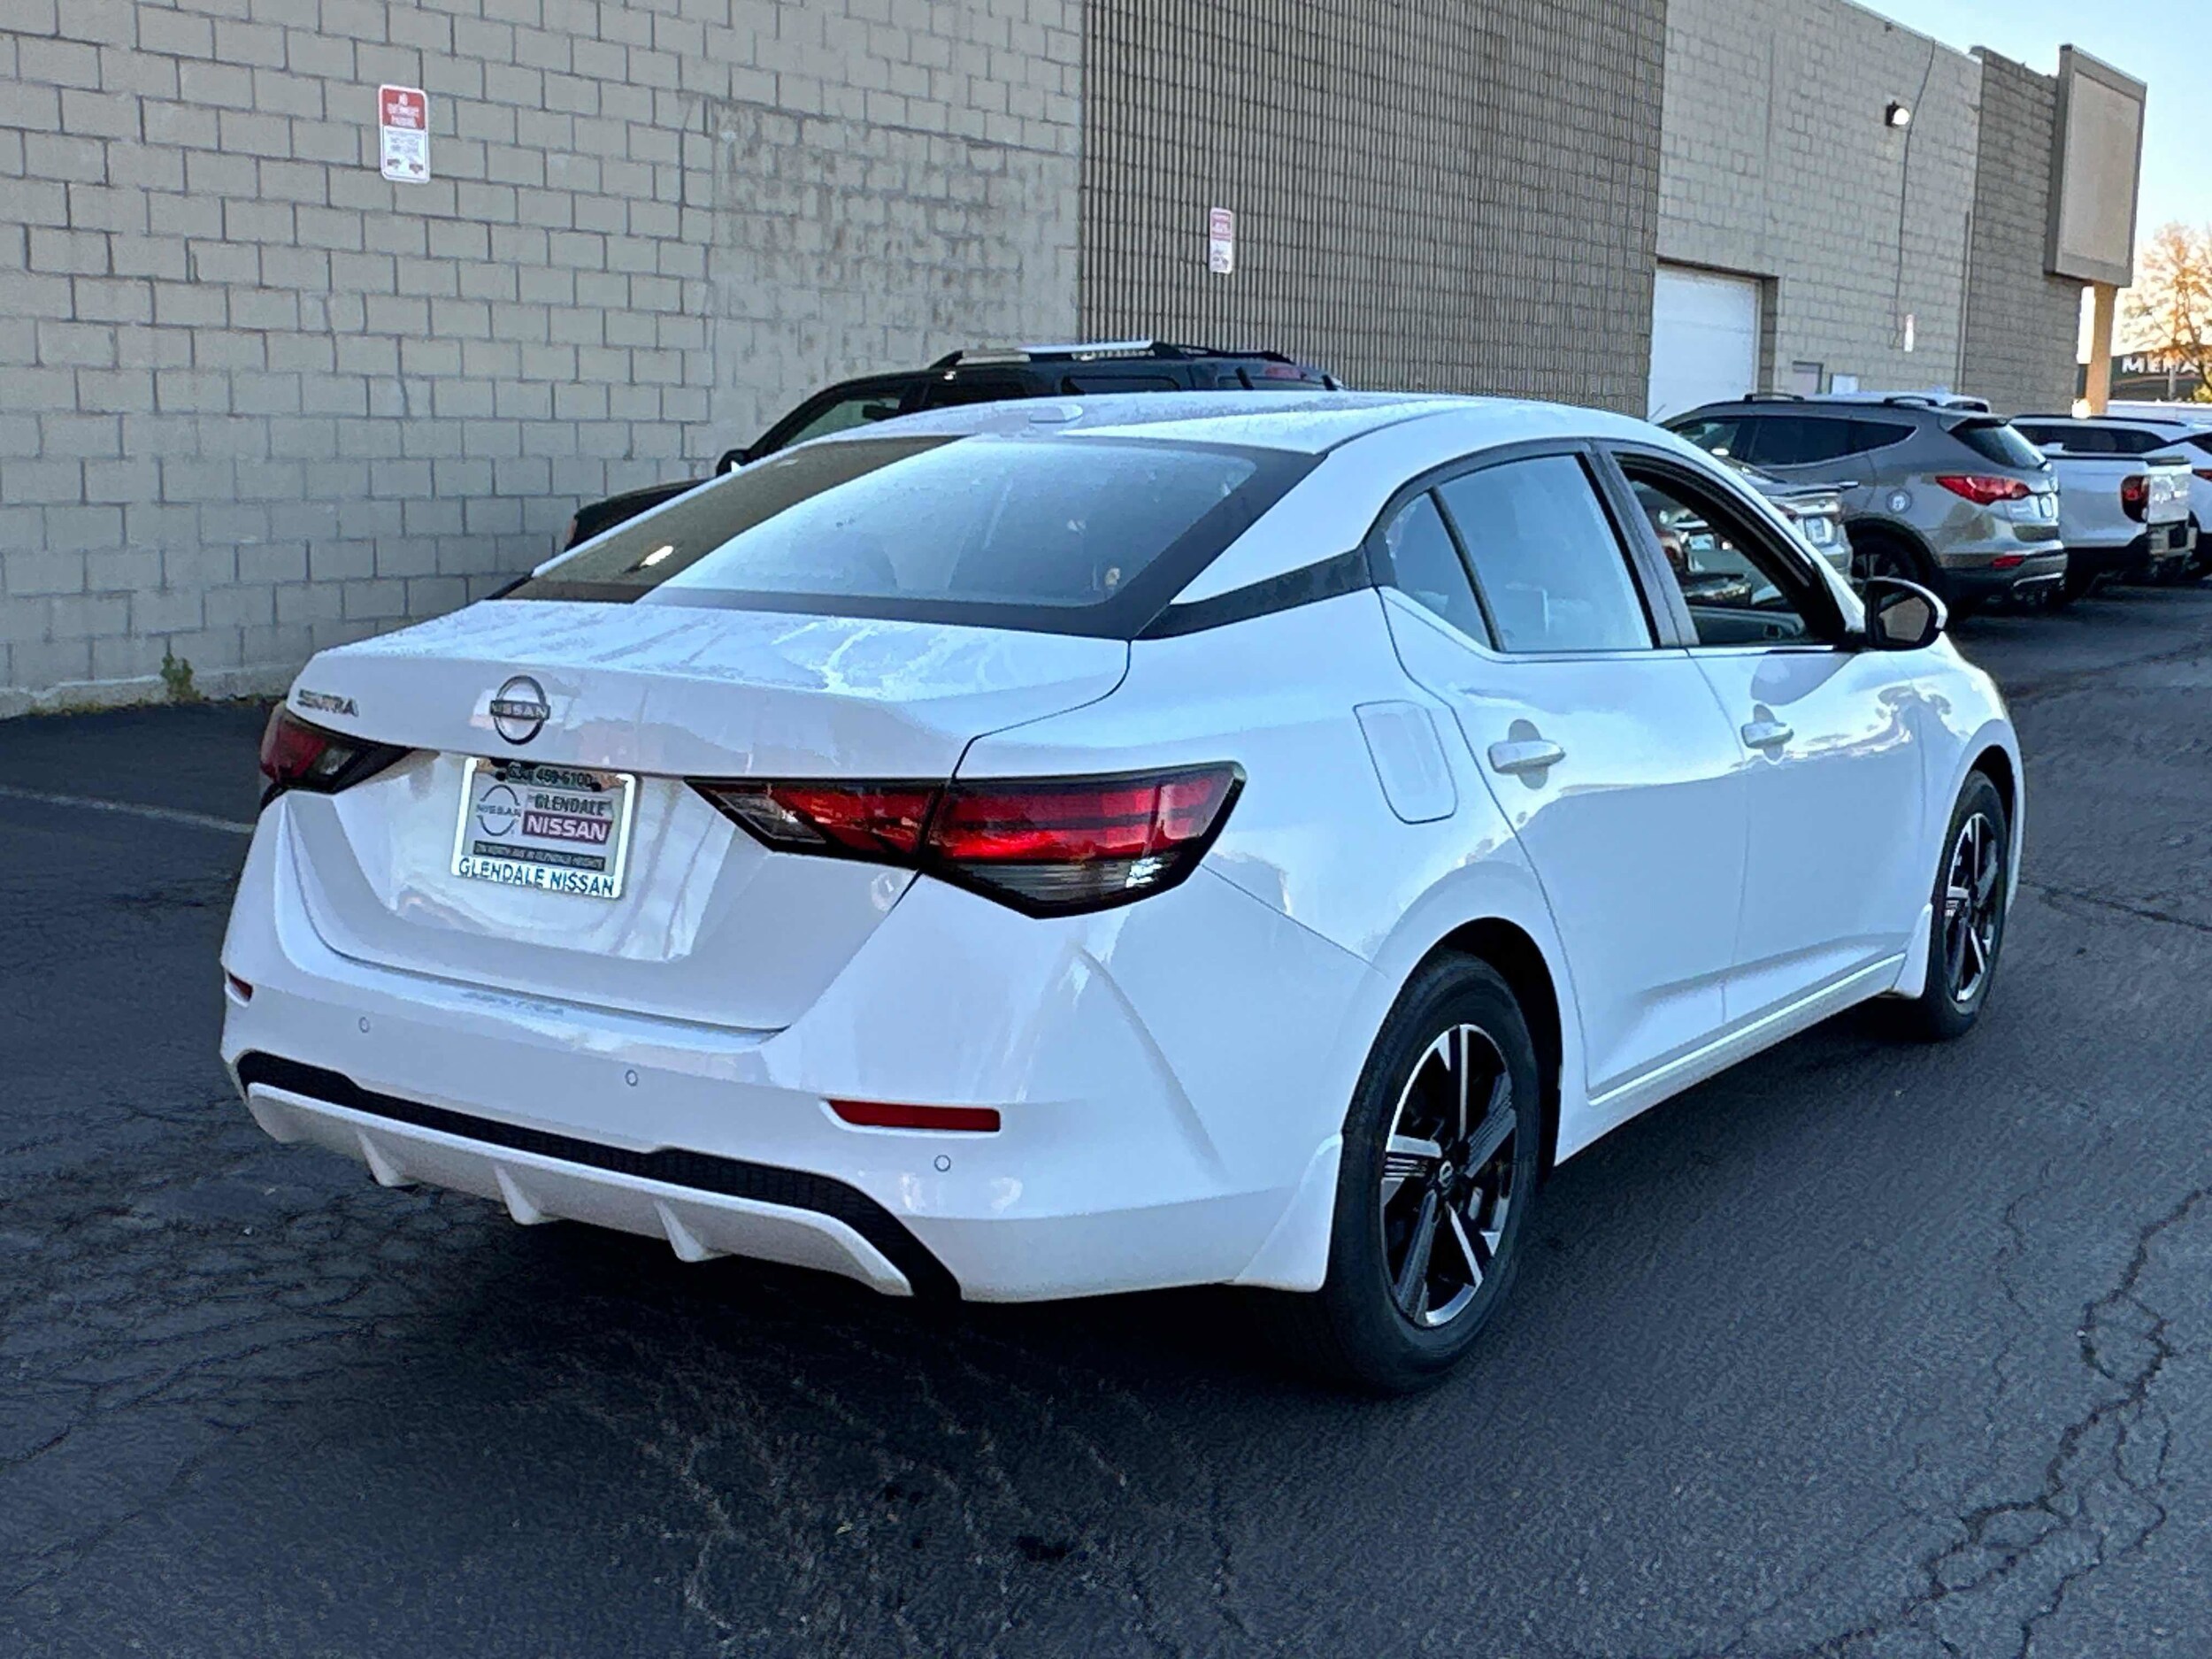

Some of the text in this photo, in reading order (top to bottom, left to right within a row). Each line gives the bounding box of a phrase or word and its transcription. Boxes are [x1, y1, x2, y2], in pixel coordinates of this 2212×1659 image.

[491, 701, 549, 719] NISSAN
[476, 803, 522, 818] NISSAN
[534, 793, 607, 817] GLENDALE
[526, 815, 608, 841] NISSAN
[458, 857, 615, 896] GLENDALE NISSAN
